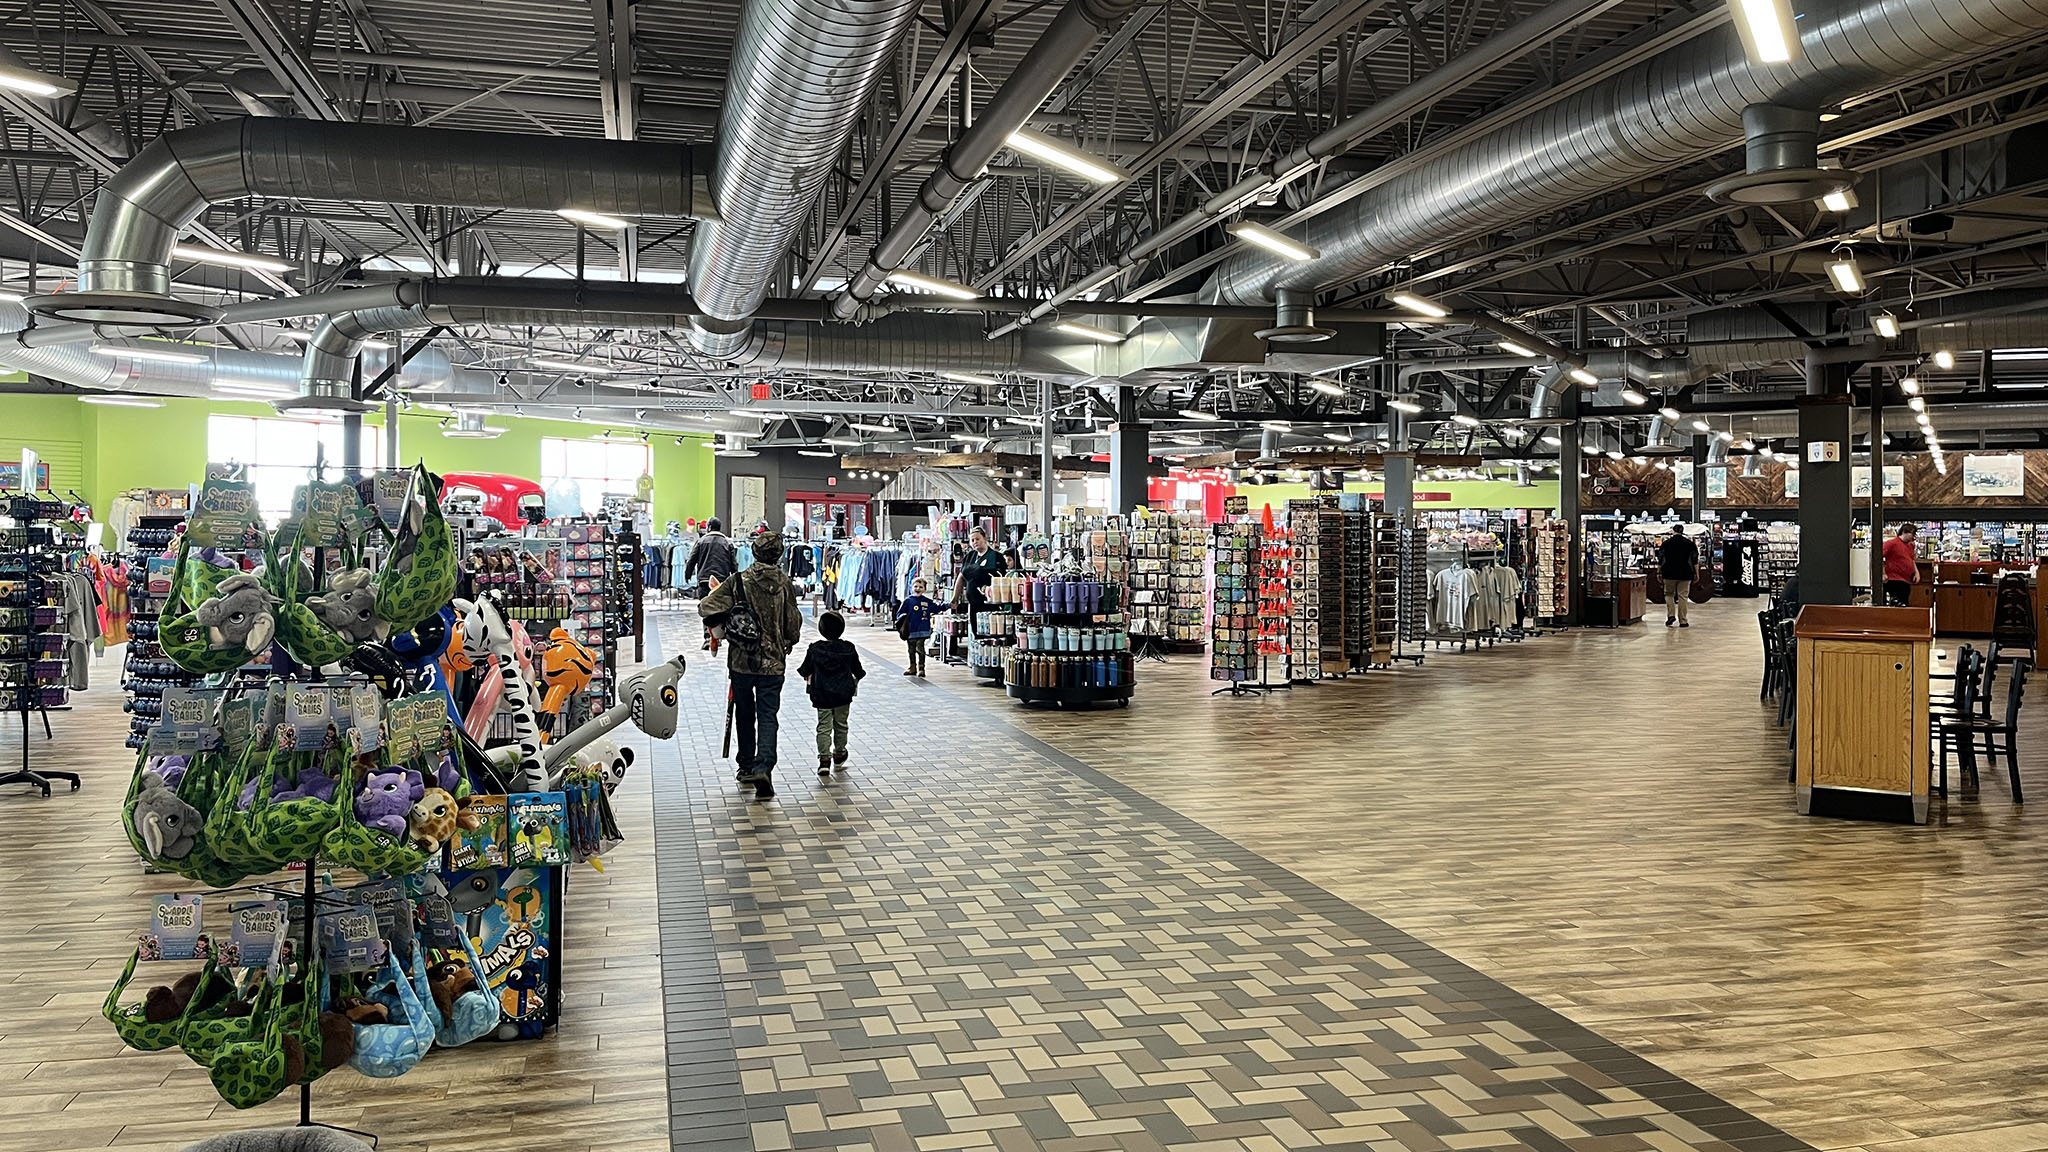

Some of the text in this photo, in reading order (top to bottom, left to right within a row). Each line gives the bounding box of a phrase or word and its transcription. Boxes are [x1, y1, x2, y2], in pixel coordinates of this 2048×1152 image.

[752, 385, 769, 399] EXIT
[209, 489, 251, 501] SWADDLE
[212, 500, 246, 513] BABIES
[1741, 553, 1753, 586] GHOST
[293, 693, 324, 706] SWADDLE
[169, 700, 206, 712] SWADDLE
[298, 704, 322, 715] BABIES
[173, 710, 203, 722] BABIES
[453, 845, 473, 856] GIANT
[159, 904, 194, 918] SWADDLE
[240, 910, 280, 923] SWADDLE
[162, 915, 192, 927] BABIES
[245, 921, 276, 933] BABIES
[483, 930, 532, 975] IMALS
